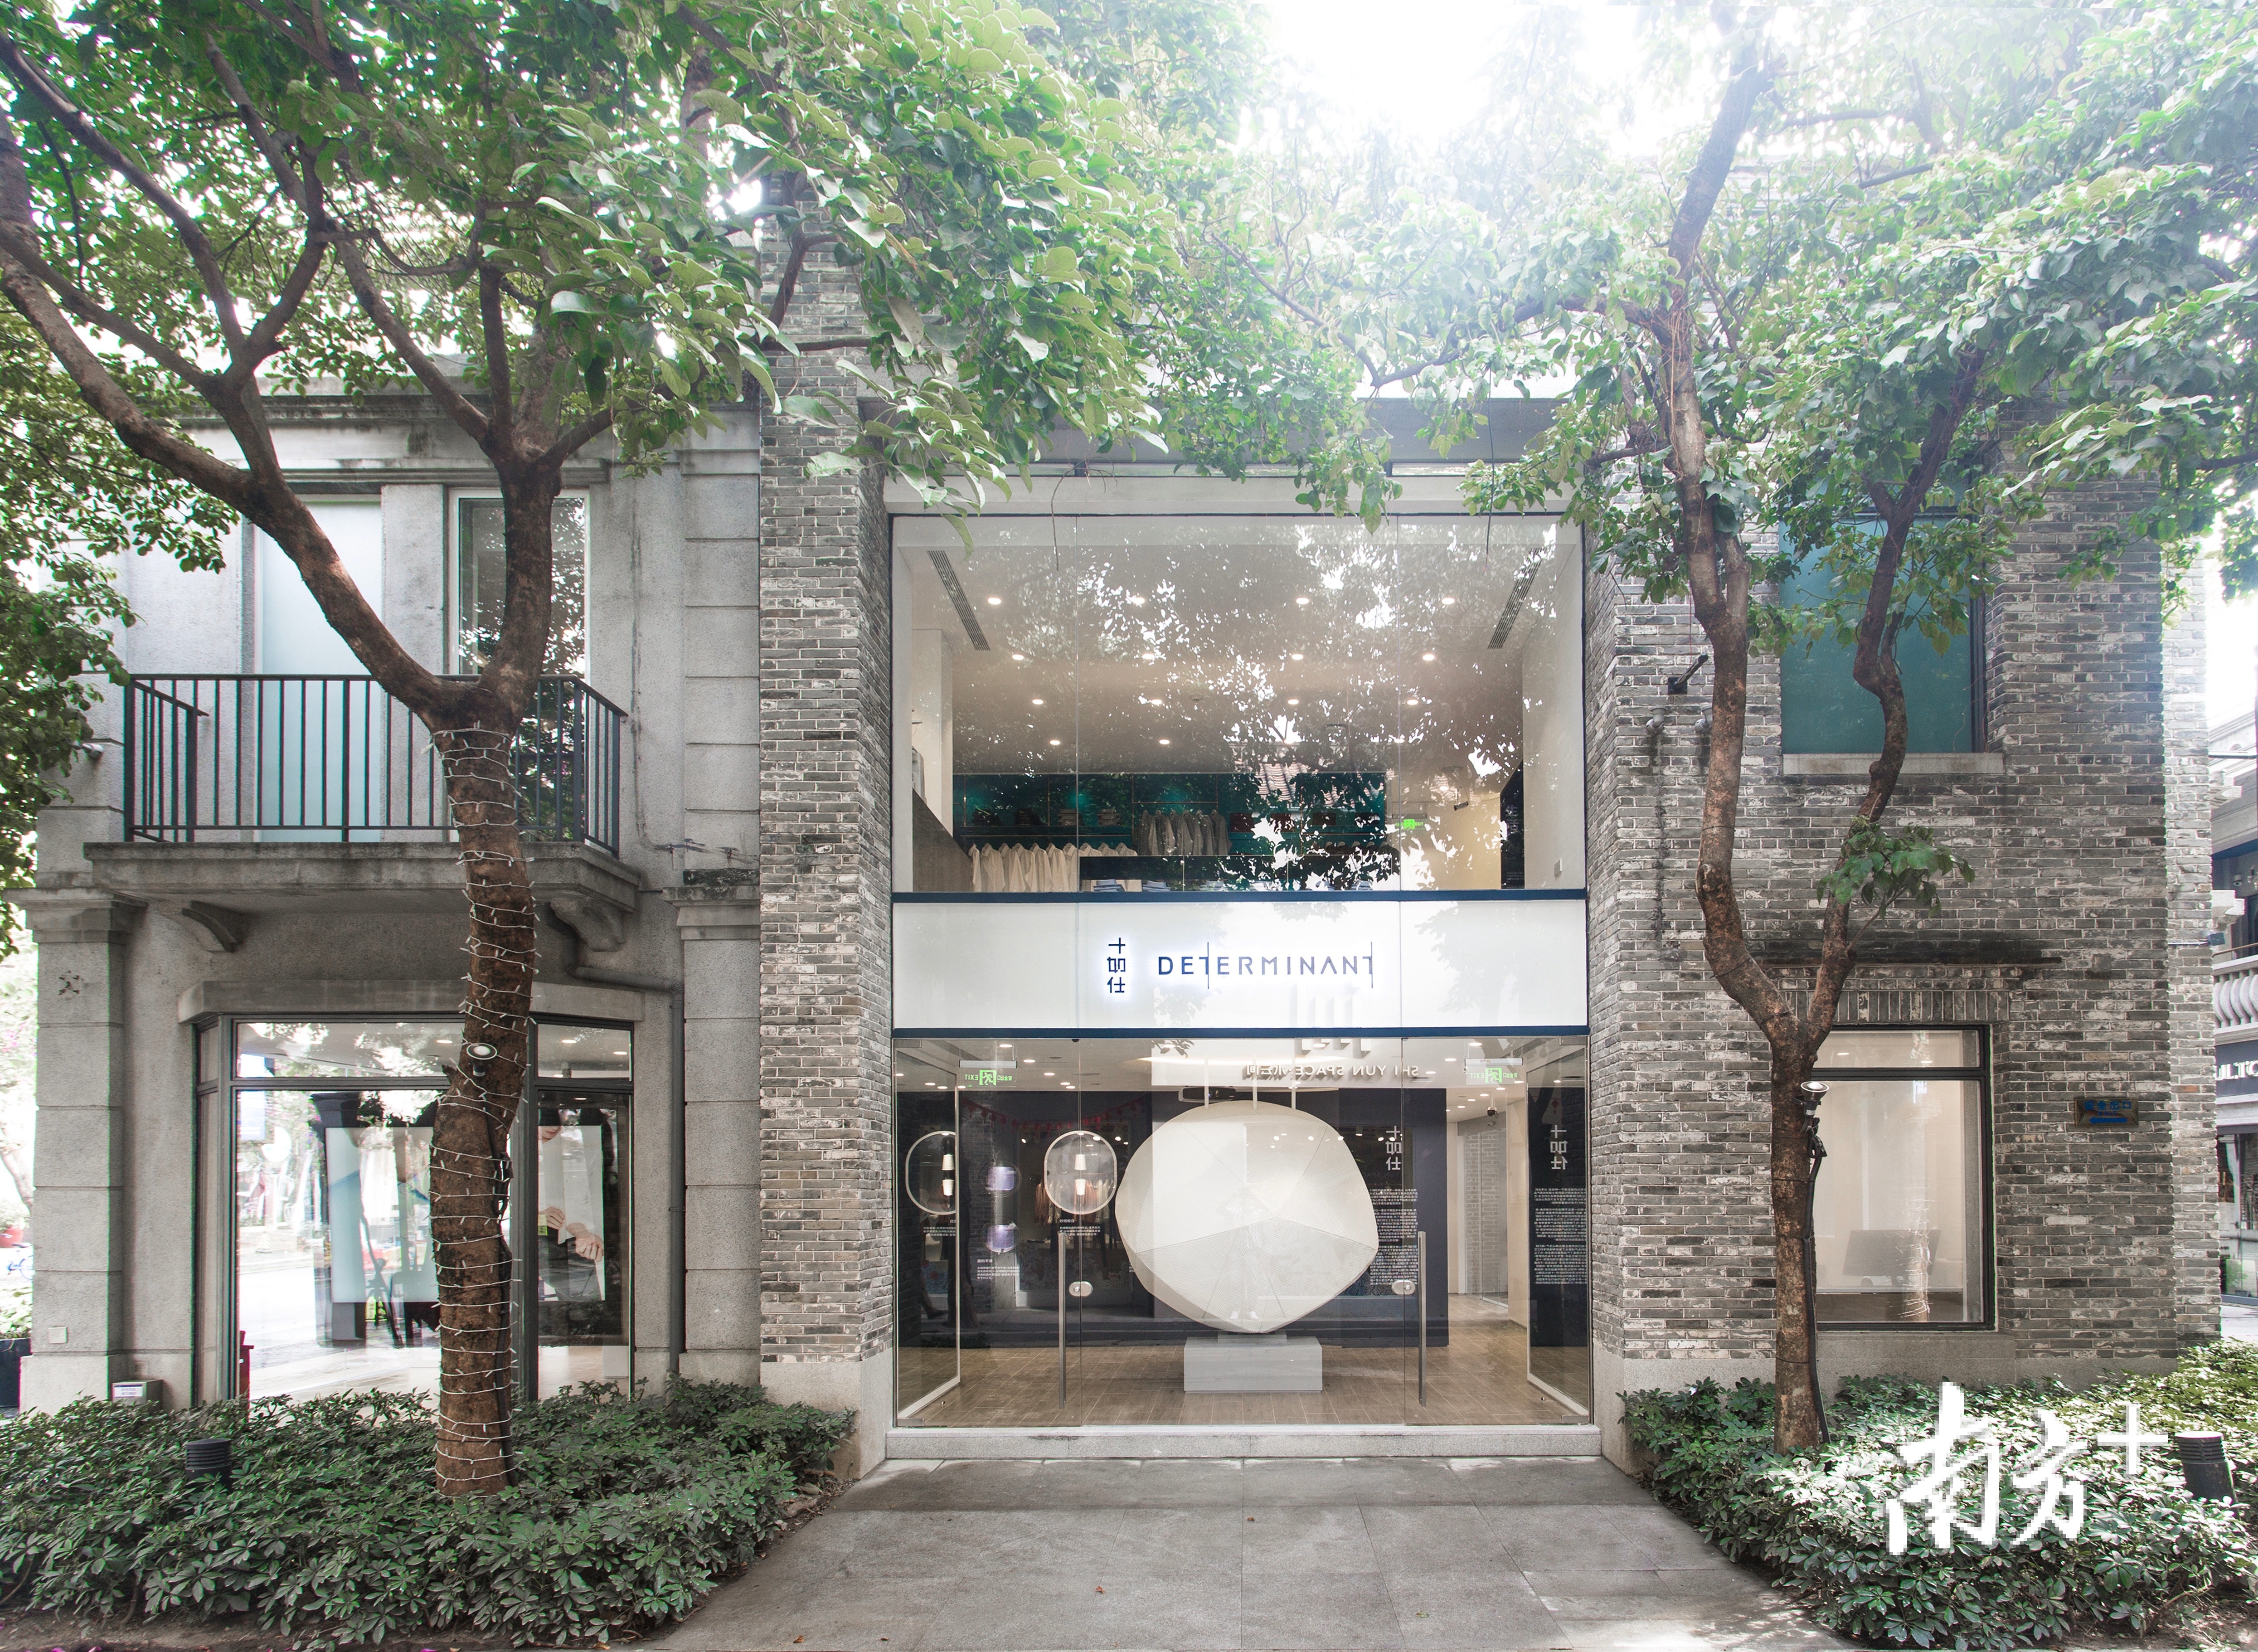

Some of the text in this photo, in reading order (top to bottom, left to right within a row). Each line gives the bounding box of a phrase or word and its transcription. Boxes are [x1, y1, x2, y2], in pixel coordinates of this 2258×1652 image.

[1107, 938, 1126, 993] 十如仕
[1158, 942, 1373, 989] DETERMINANT
[2084, 1100, 2132, 1111] 安全出口
